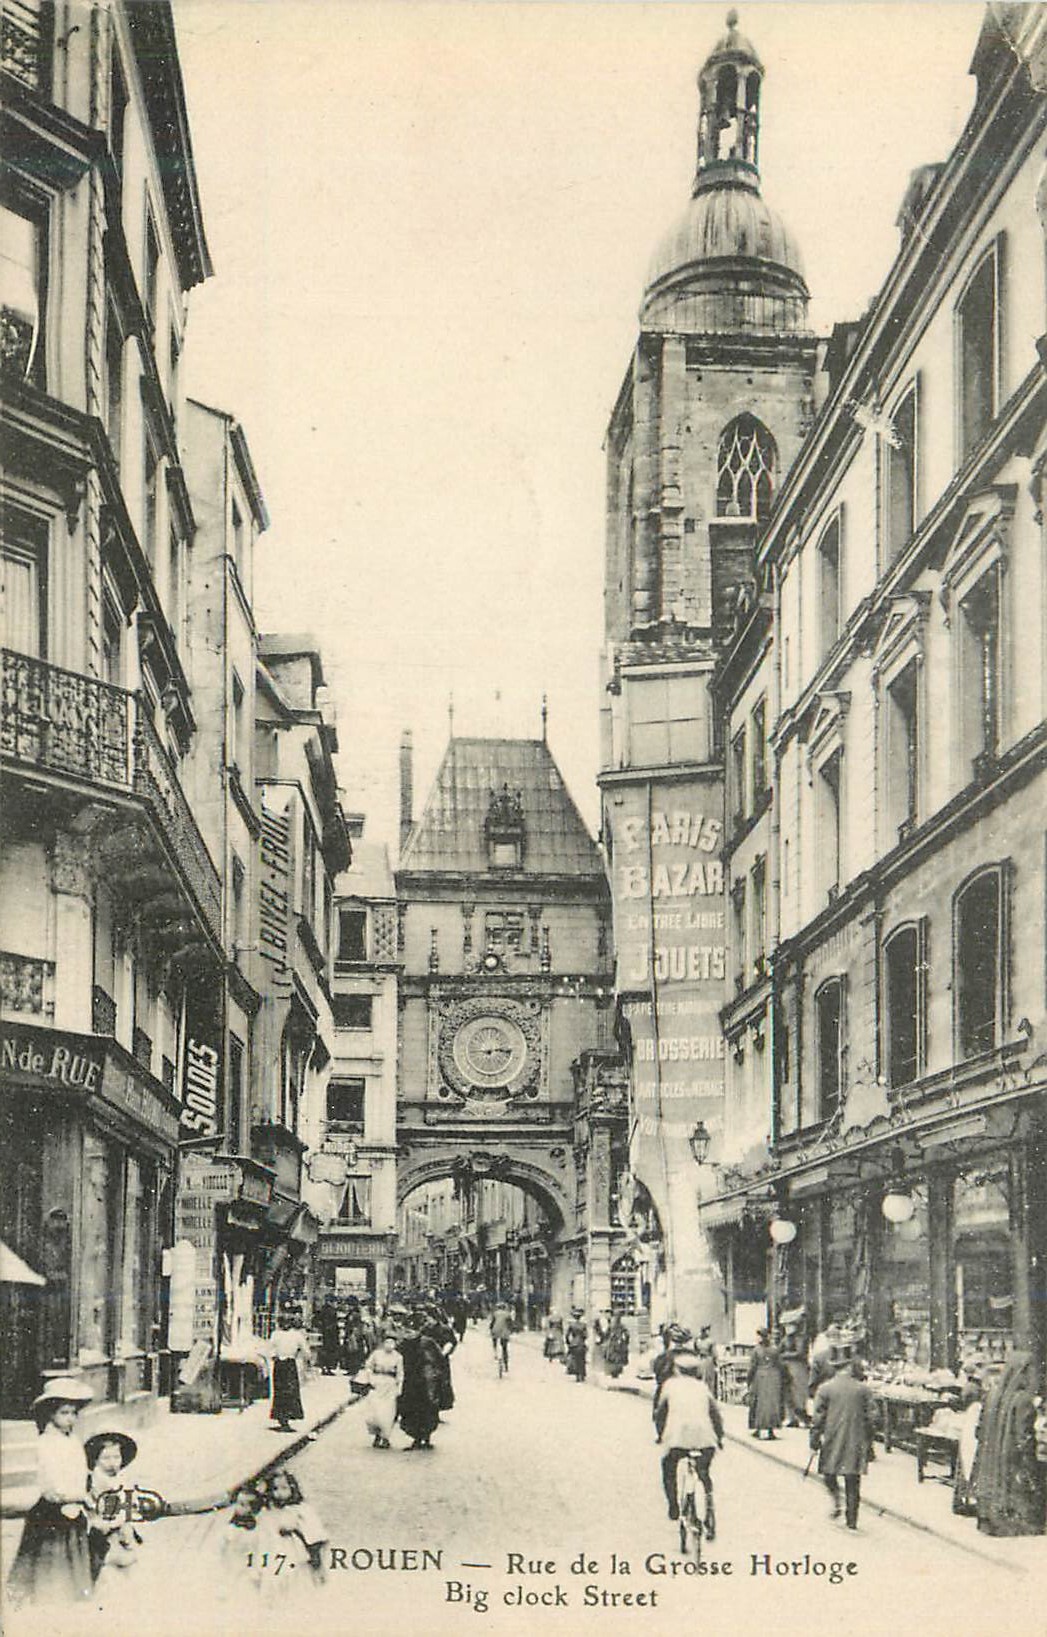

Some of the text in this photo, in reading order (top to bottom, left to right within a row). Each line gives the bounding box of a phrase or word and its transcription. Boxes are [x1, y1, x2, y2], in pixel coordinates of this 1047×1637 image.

[621, 812, 723, 853] PARIS
[620, 861, 725, 898] BAZAR
[630, 943, 725, 981] JOUETS
[44, 1046, 101, 1092] RUE
[180, 1039, 218, 1136] SOLDES
